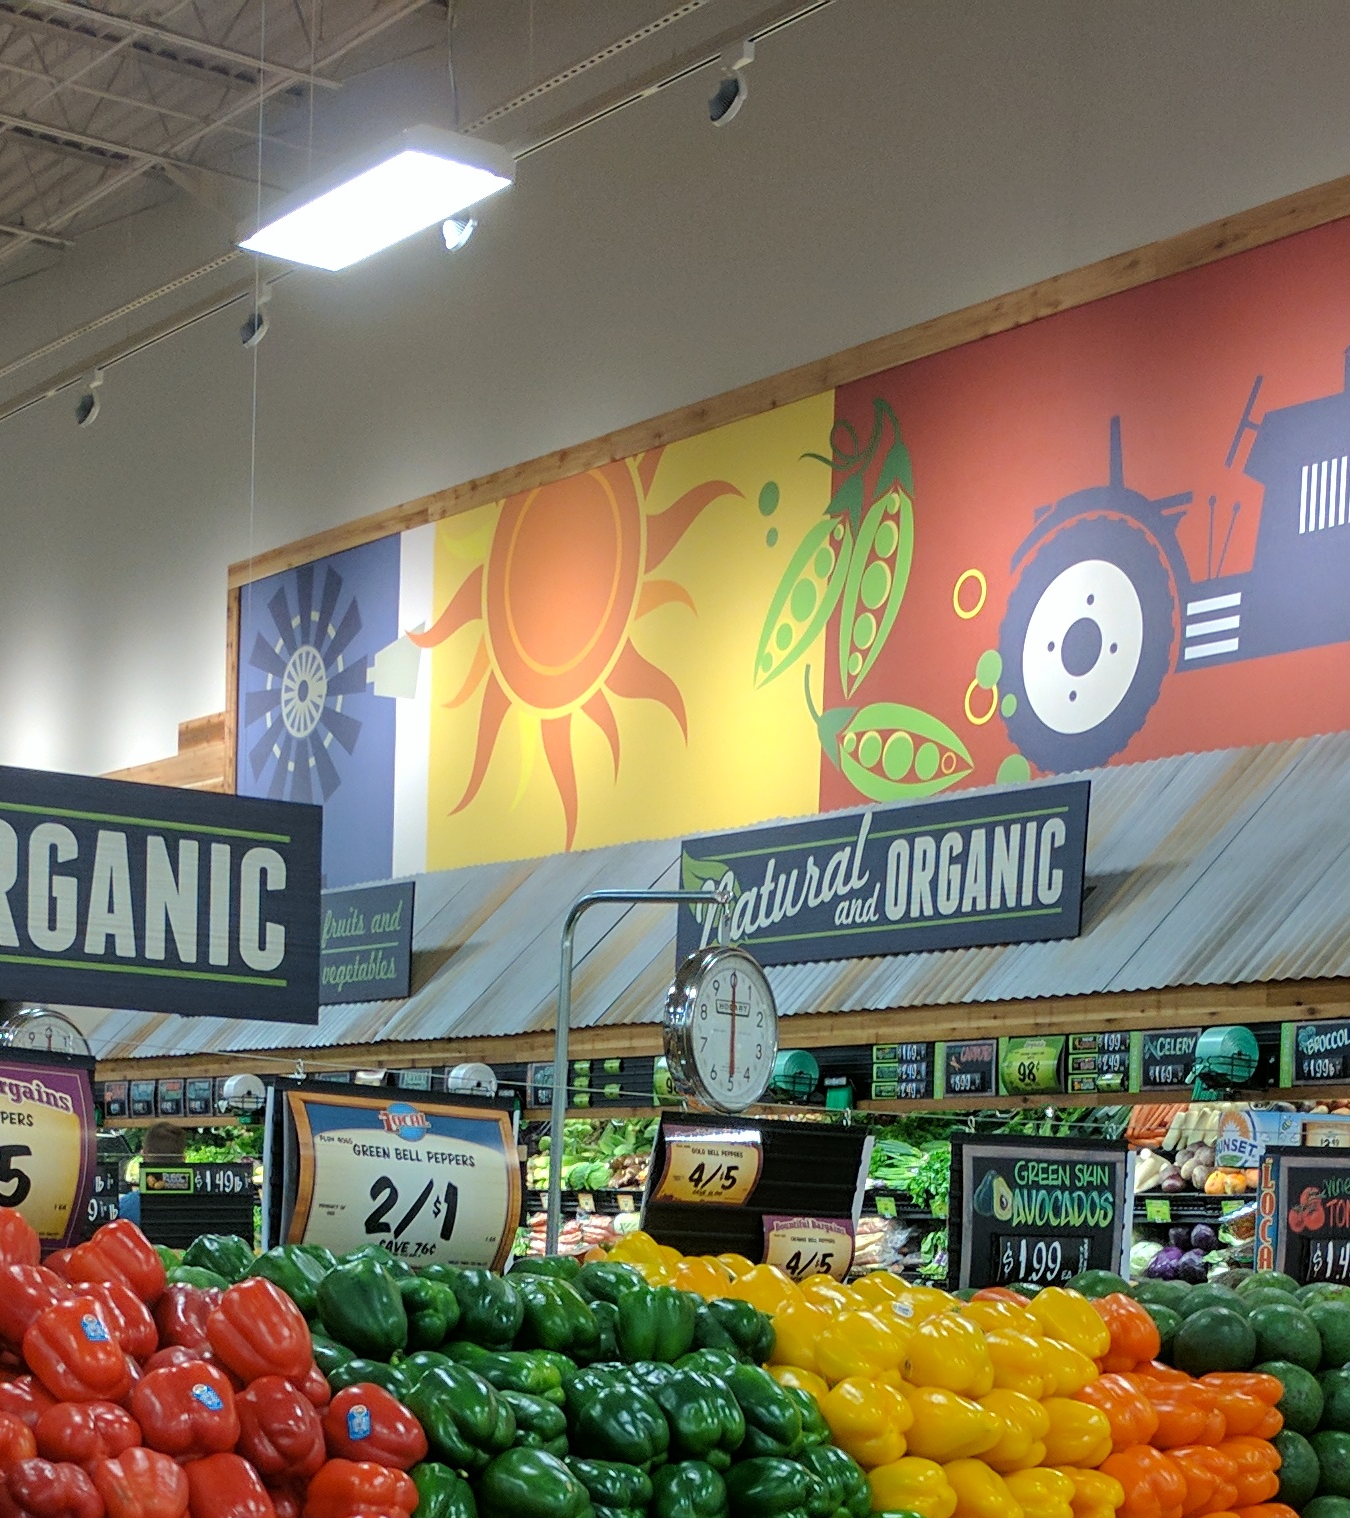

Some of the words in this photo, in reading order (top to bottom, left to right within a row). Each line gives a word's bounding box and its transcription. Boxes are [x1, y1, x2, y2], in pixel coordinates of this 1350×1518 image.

[696, 809, 871, 951] Natural
[835, 882, 881, 926] and
[884, 817, 1068, 922] ORGANIC
[321, 907, 366, 948] fruits
[371, 900, 403, 933] and
[322, 949, 397, 992] vegetables
[1157, 1036, 1196, 1055] CELERY
[353, 1144, 391, 1159] GREEN
[395, 1147, 422, 1162] BELL
[427, 1151, 476, 1167] PEPPERS
[1014, 1160, 1070, 1187] GREEN
[1075, 1164, 1109, 1187] SKIN
[364, 1175, 459, 1241] 2/$1
[773, 1217, 809, 1232] Bountiful
[810, 1219, 847, 1235] Bargains
[1012, 1188, 1113, 1228] AVOCADOS
[1002, 1239, 1061, 1281] $1.99
